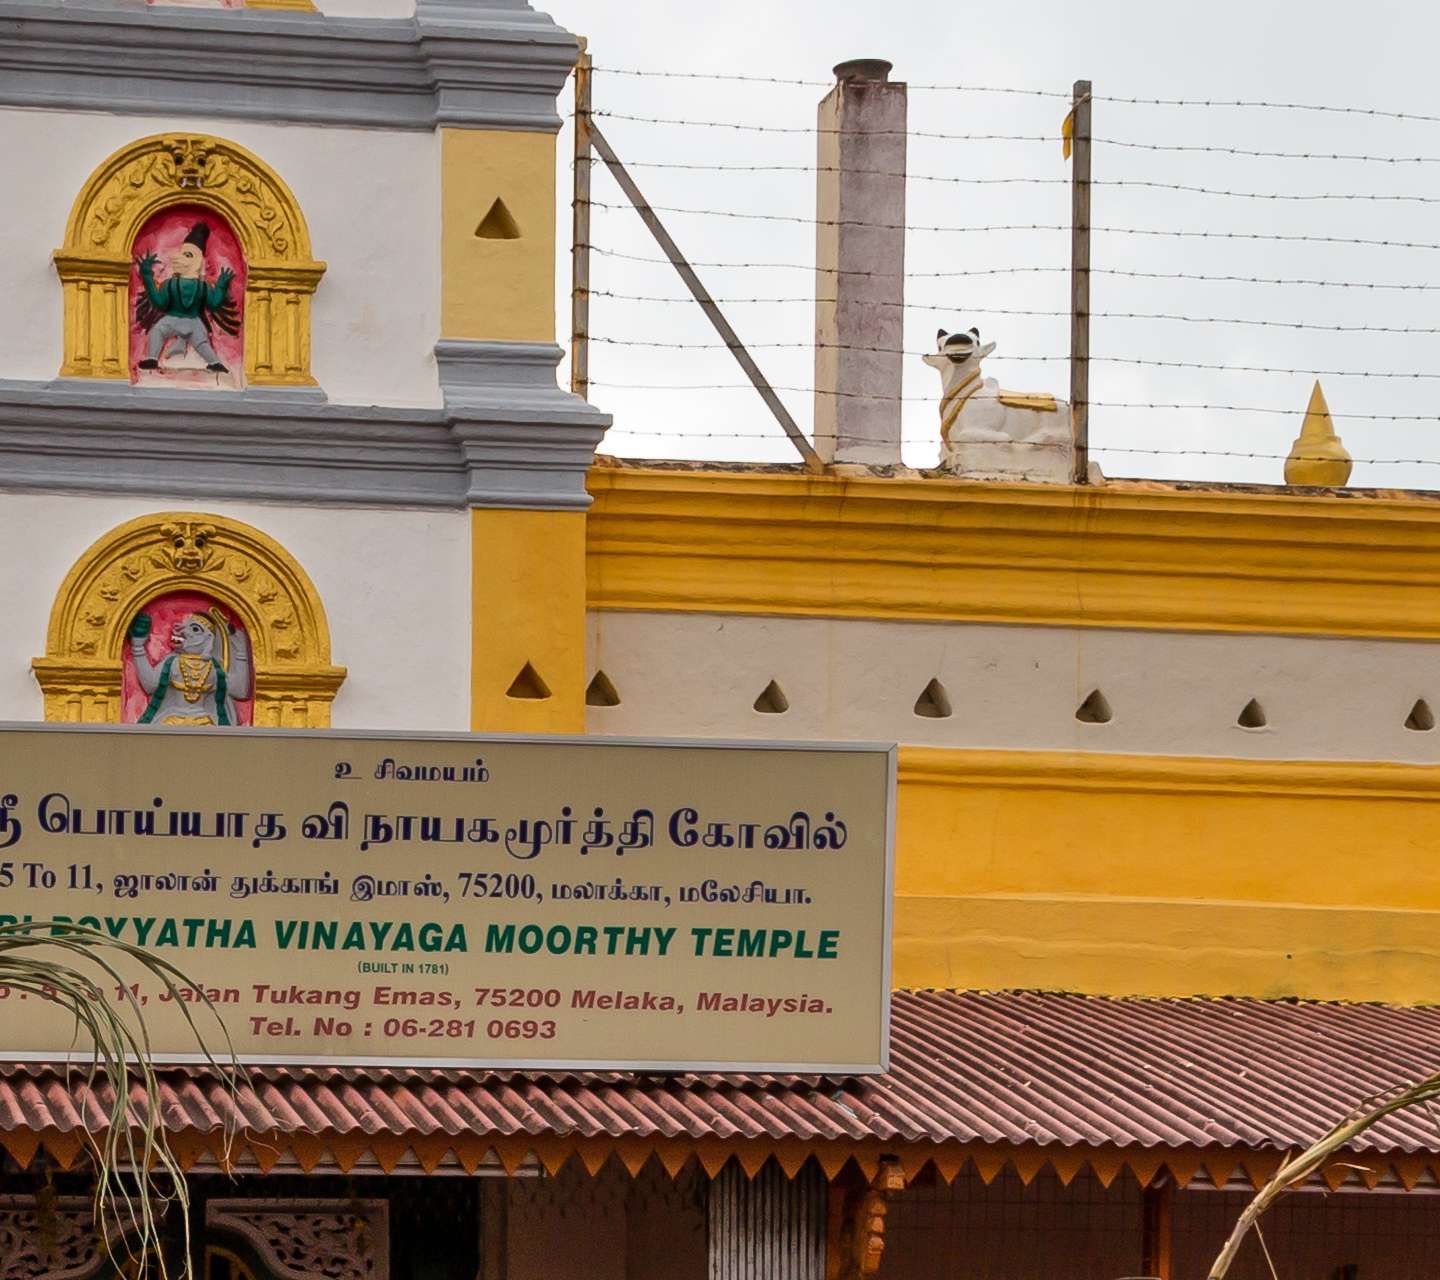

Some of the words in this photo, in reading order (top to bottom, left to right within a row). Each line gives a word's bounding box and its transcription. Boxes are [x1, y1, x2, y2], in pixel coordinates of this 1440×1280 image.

[374, 758, 490, 782] சிவமயம்
[37, 792, 287, 849] பொய்யாத
[668, 806, 848, 851] கோவில்
[23, 863, 57, 889] To
[66, 864, 103, 895] 11,
[113, 868, 222, 898] ஜாலான்
[458, 872, 544, 904] 75200,
[551, 877, 671, 908] மலாக்கா,
[275, 919, 468, 953] VINAYAGA
[484, 924, 678, 957] MOORTHY
[691, 927, 841, 960] TEMPLE
[357, 961, 398, 974] (BUILT
[402, 963, 414, 974] IN
[419, 963, 449, 976] 1781)
[158, 983, 241, 1004] Jalan
[251, 984, 362, 1010] Tukang
[373, 986, 462, 1010] Emas,
[473, 987, 562, 1009] 75200
[570, 988, 685, 1016] Melaka,
[695, 991, 834, 1017] Malaysia.
[249, 1017, 301, 1037] Tel.
[313, 1017, 353, 1037] No
[383, 1017, 476, 1040] 06-281
[486, 1019, 558, 1040] 0693
